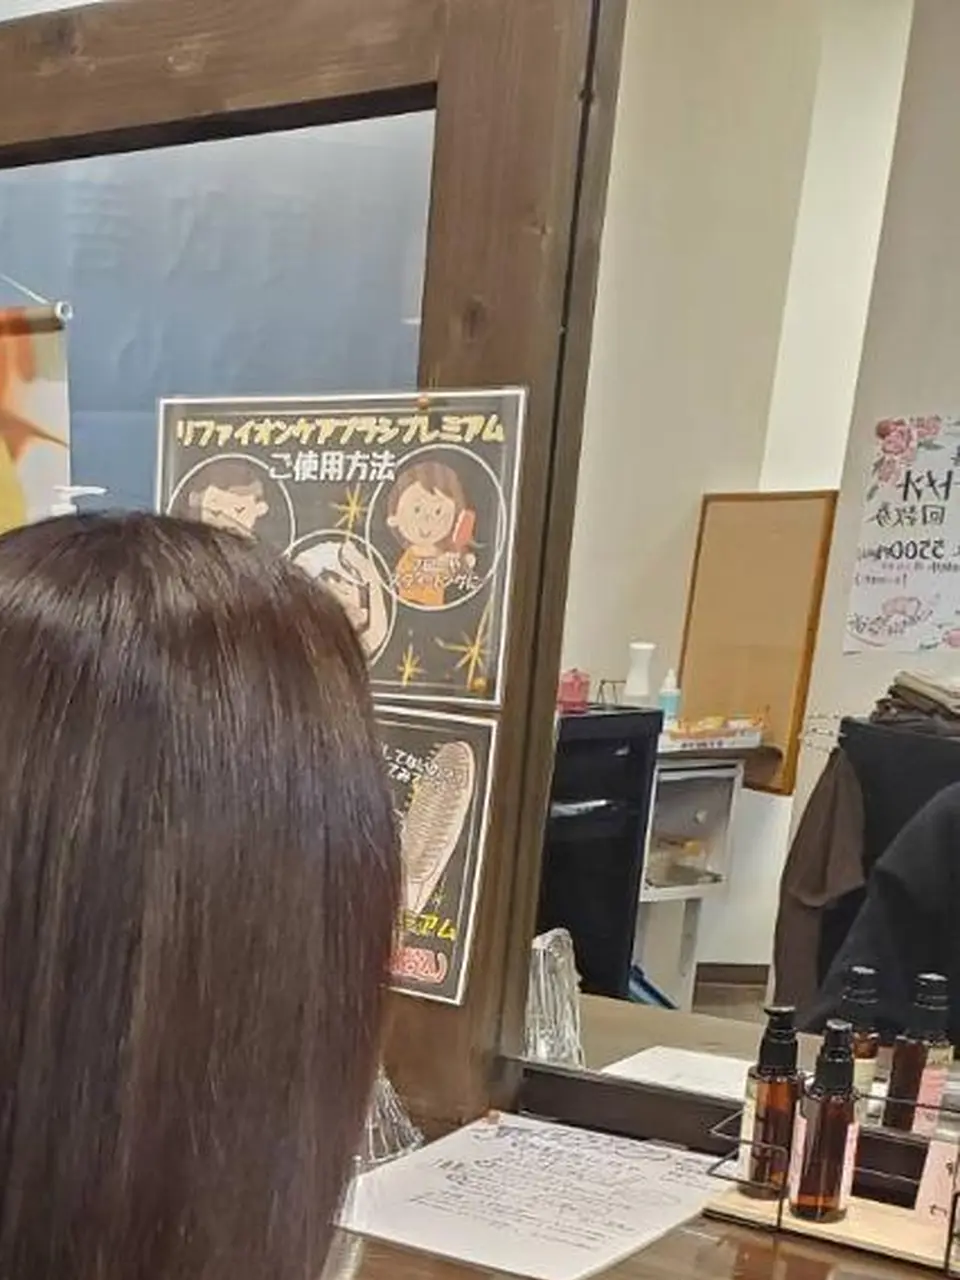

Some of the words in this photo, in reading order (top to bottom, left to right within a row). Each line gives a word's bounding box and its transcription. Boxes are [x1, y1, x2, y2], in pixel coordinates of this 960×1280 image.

[176, 413, 506, 447] リファイオンケアブラシプレミアム
[268, 450, 397, 482] ご使用方法
